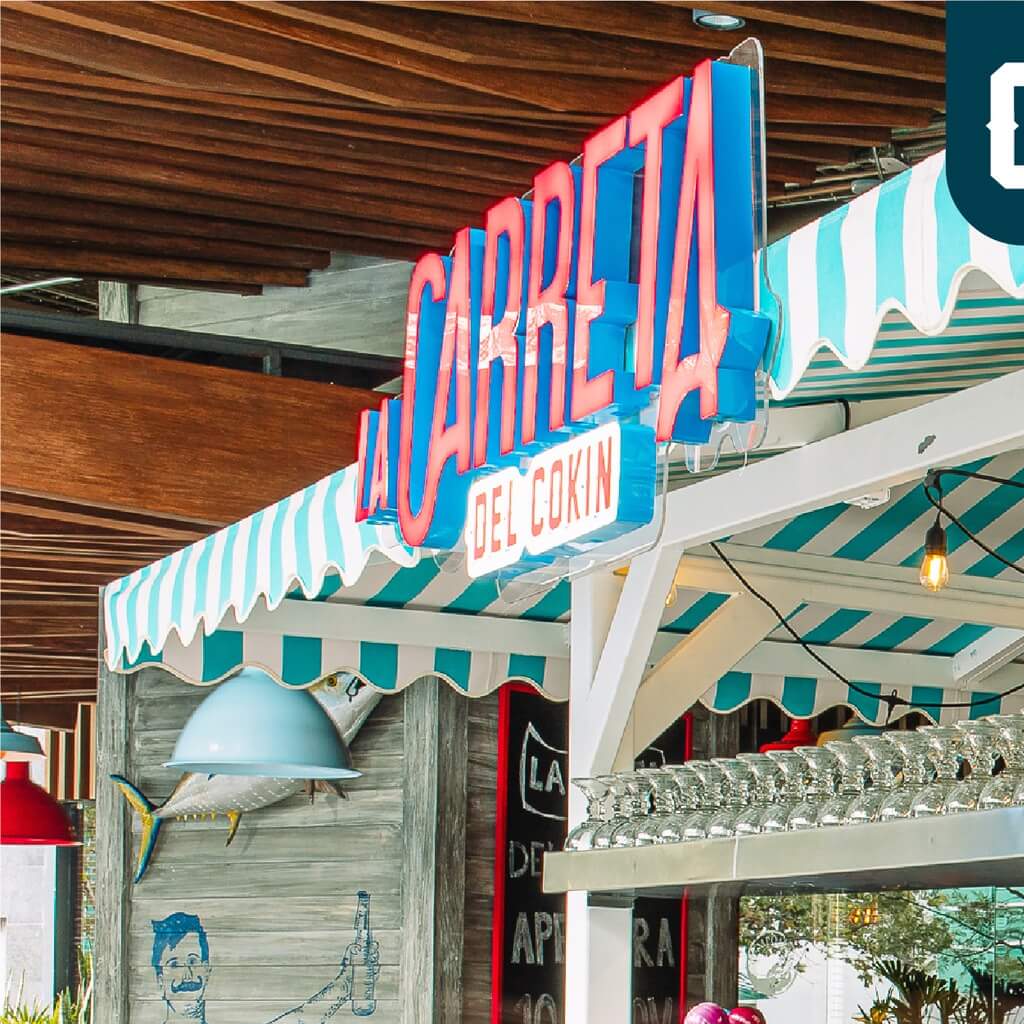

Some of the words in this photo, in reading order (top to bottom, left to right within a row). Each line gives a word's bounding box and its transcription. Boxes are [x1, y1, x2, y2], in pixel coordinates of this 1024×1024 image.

[356, 398, 390, 523] LA
[398, 58, 731, 547] CARRETA
[474, 480, 517, 560] DEL
[531, 436, 613, 537] COKIN
[529, 755, 566, 796] LA
